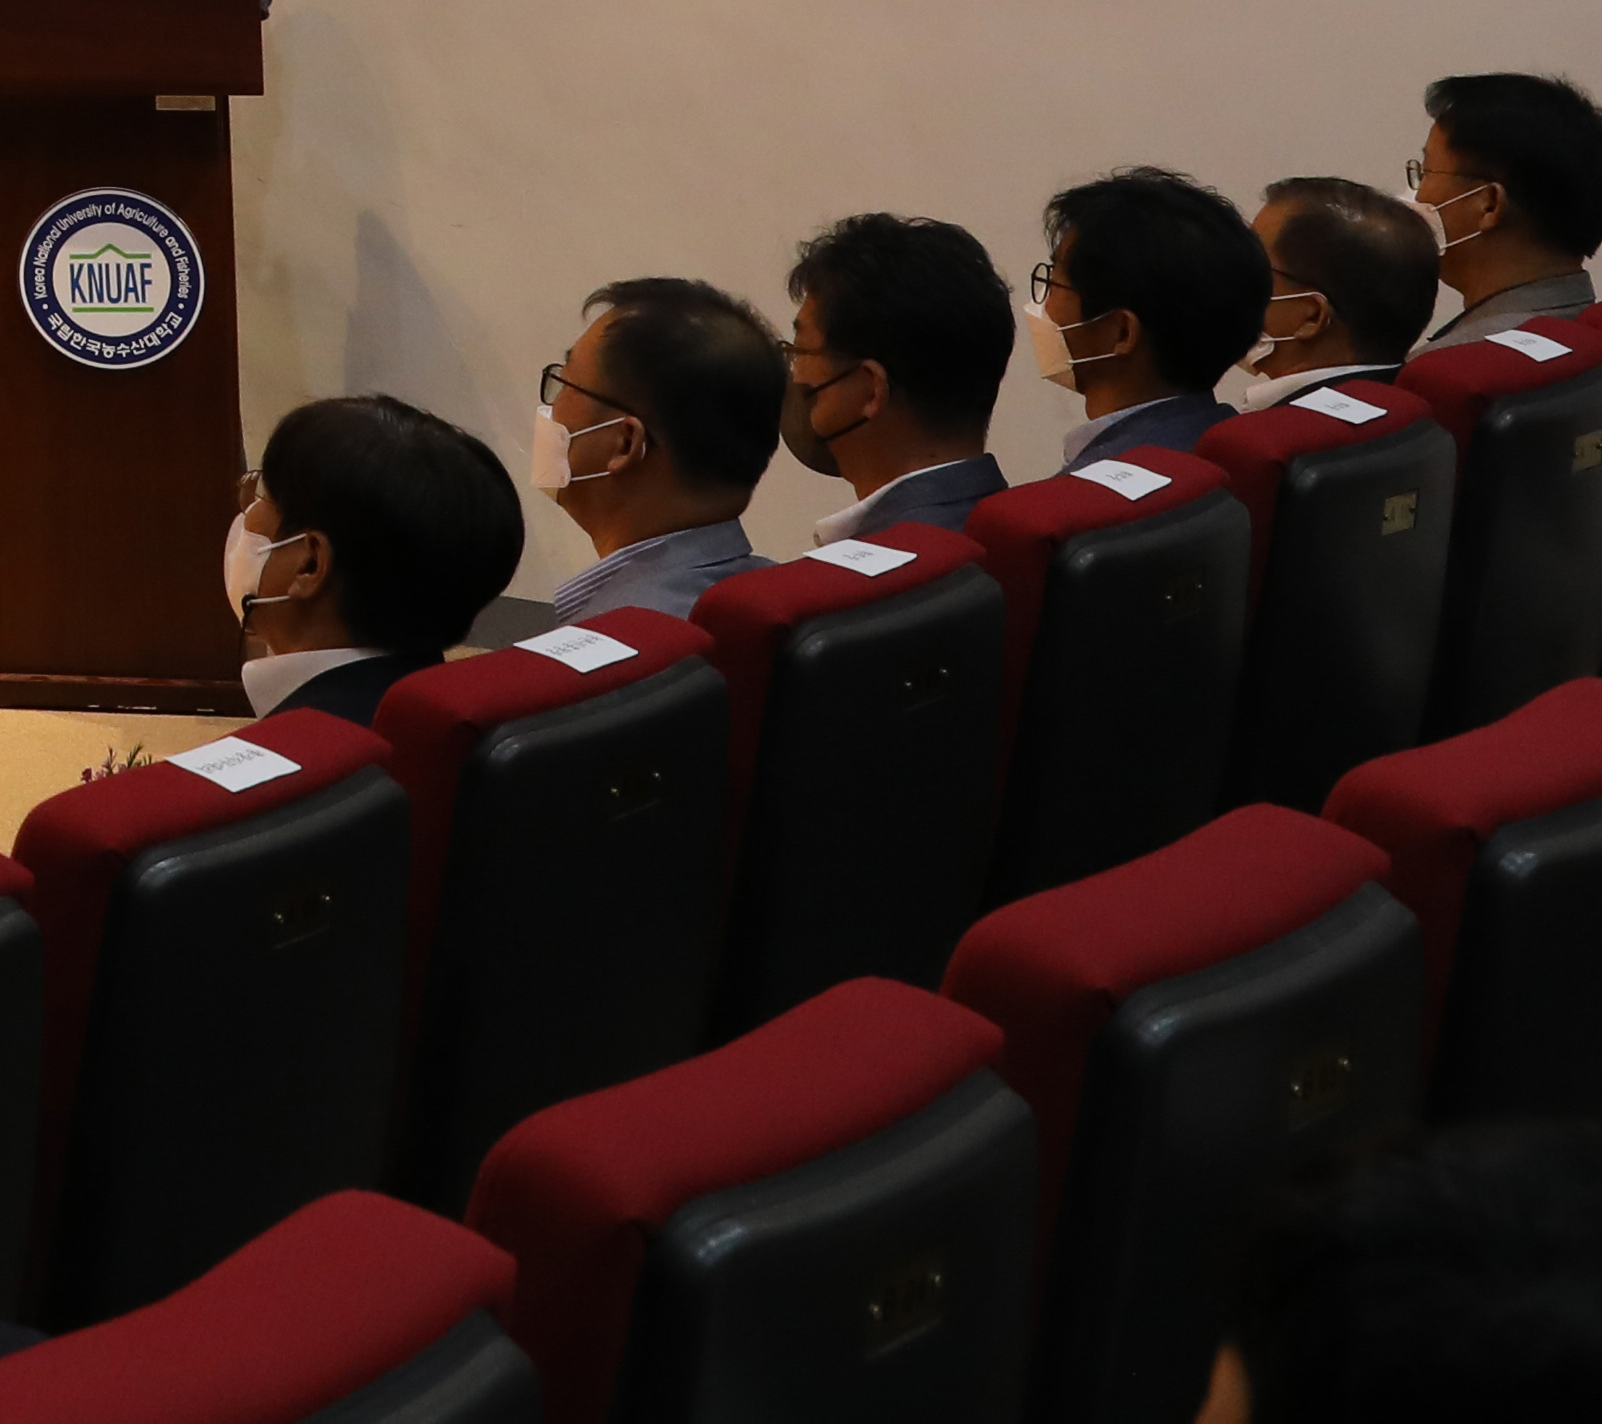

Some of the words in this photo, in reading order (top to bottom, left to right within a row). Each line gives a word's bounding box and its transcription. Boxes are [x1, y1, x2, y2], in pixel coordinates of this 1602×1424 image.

[58, 203, 102, 231] University
[104, 202, 116, 214] of
[117, 203, 169, 237] Agriculture
[33, 225, 59, 269] National
[165, 236, 183, 257] and
[33, 268, 48, 300] Korea
[69, 262, 152, 304] KNUAF
[175, 253, 191, 299] Fisheries
[47, 312, 182, 358] 국립한국농수산대학교
